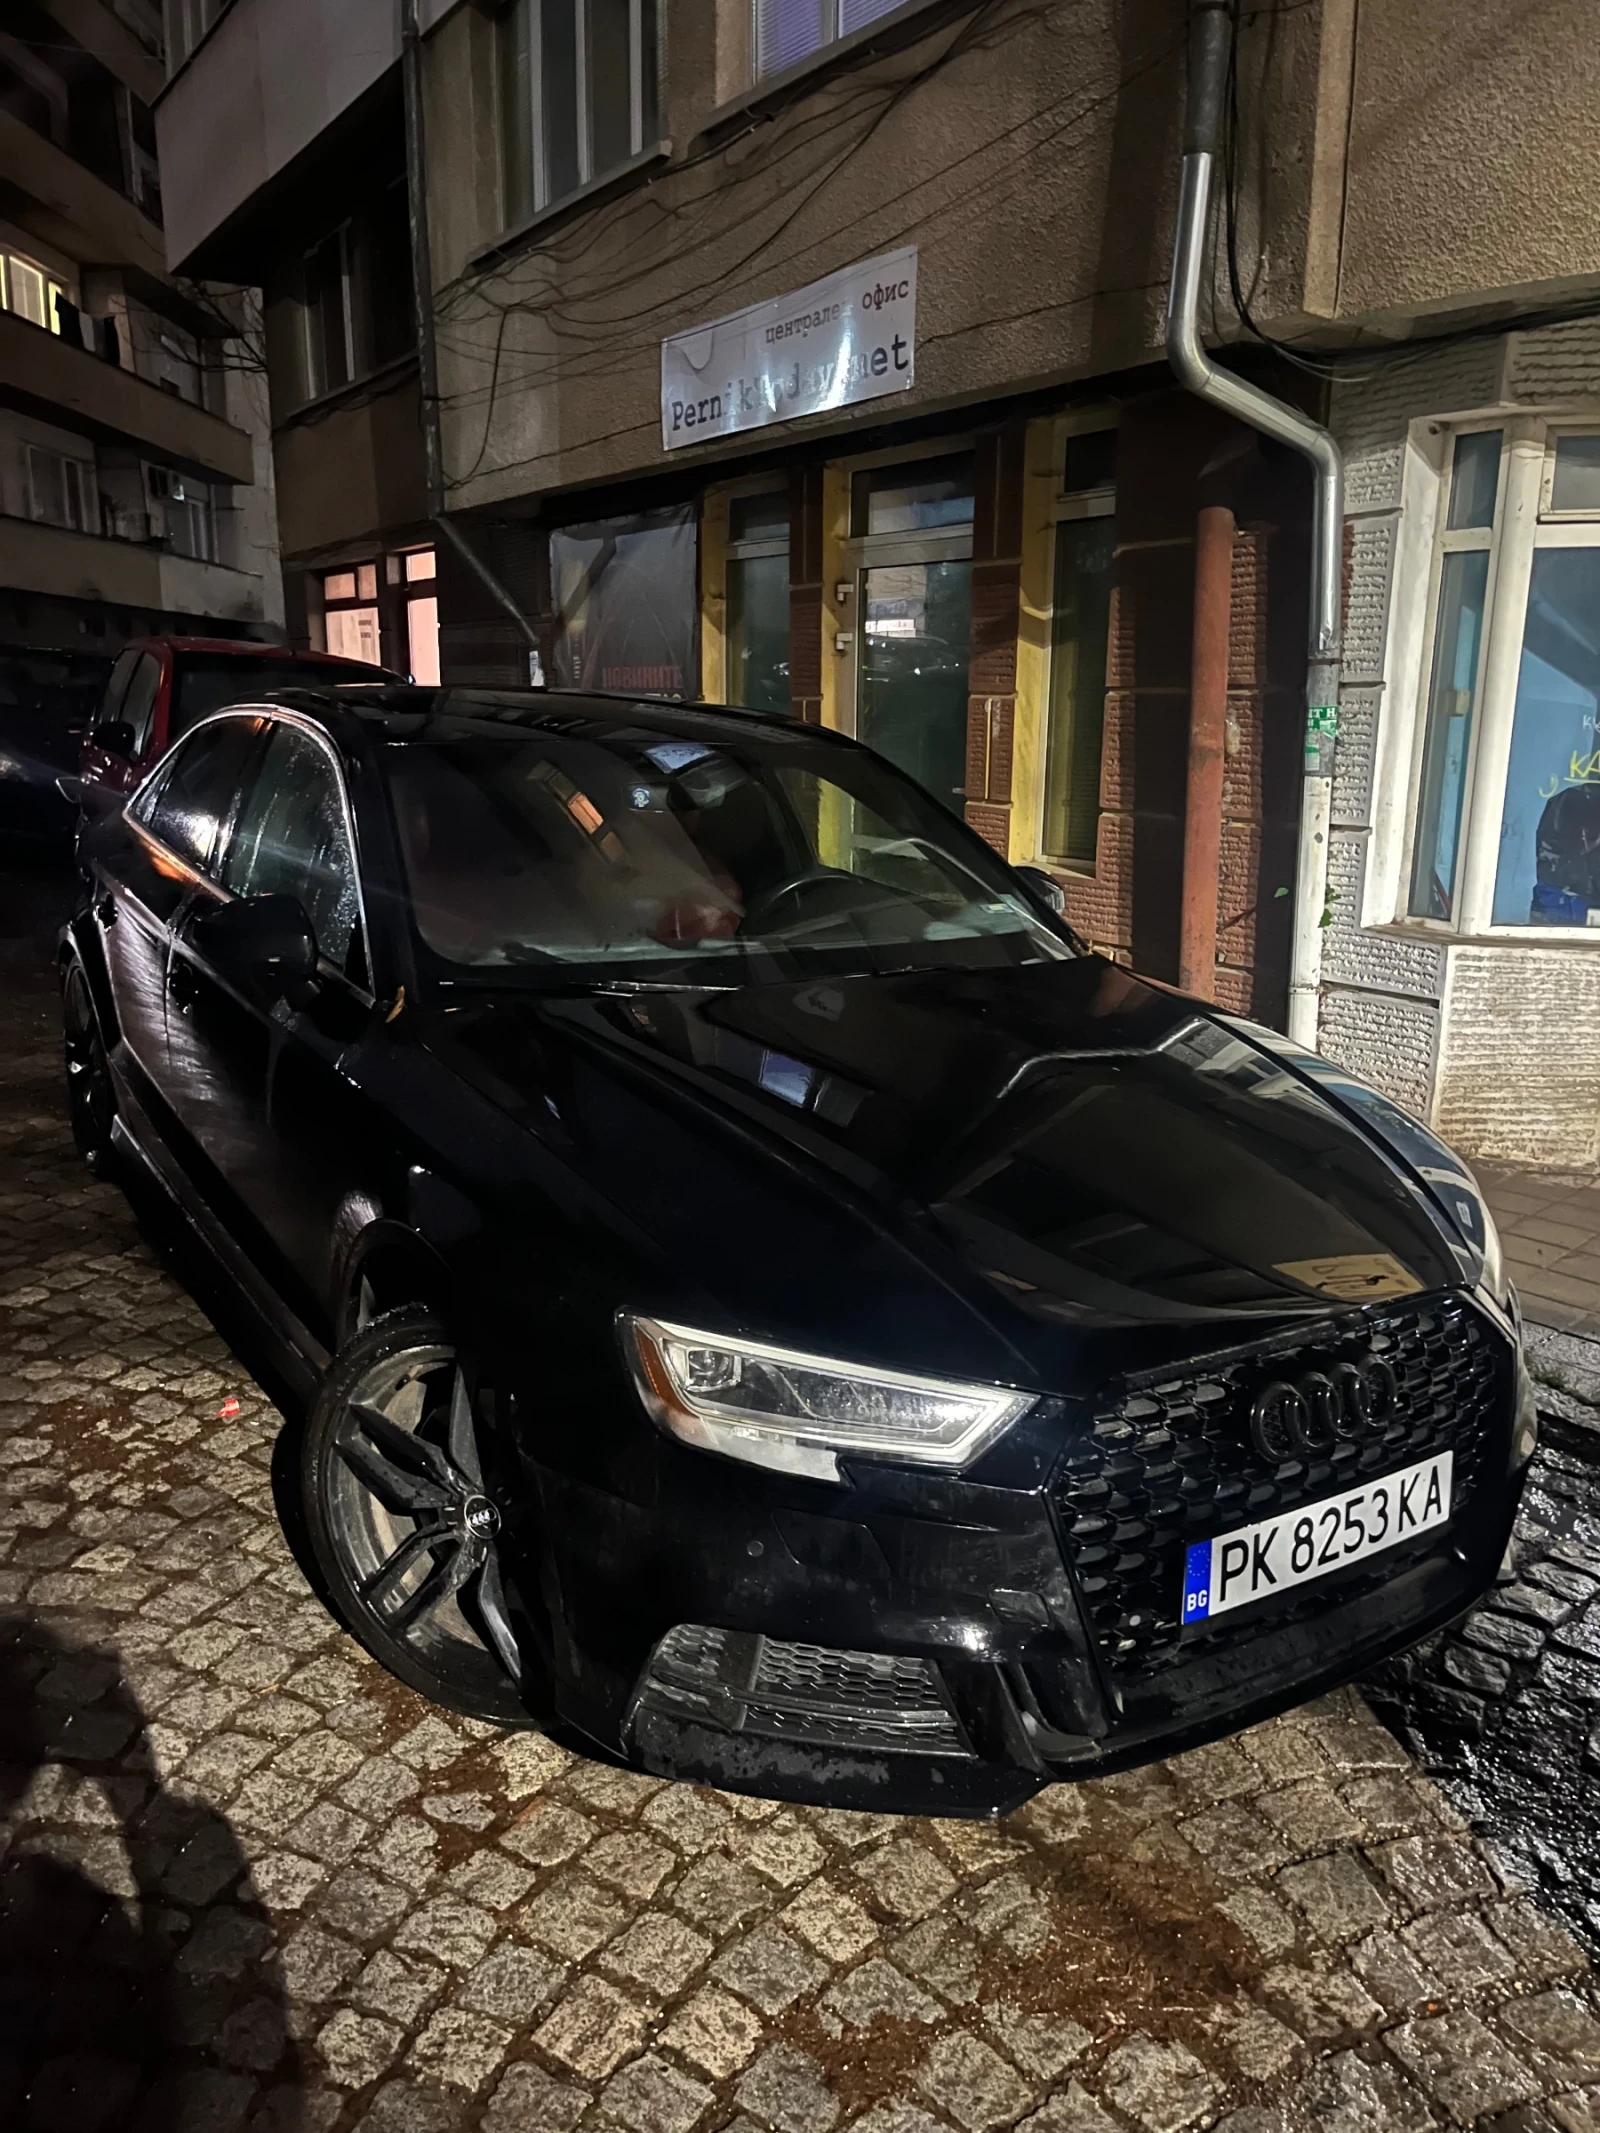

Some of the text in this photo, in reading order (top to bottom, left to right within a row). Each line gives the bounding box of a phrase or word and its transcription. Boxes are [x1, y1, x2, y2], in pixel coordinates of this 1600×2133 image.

[862, 279, 909, 311] офис
[601, 665, 684, 689] НОВИНИТЕ
[1219, 1465, 1442, 1602] PK 8253 KA
[1186, 1590, 1208, 1612] BG
